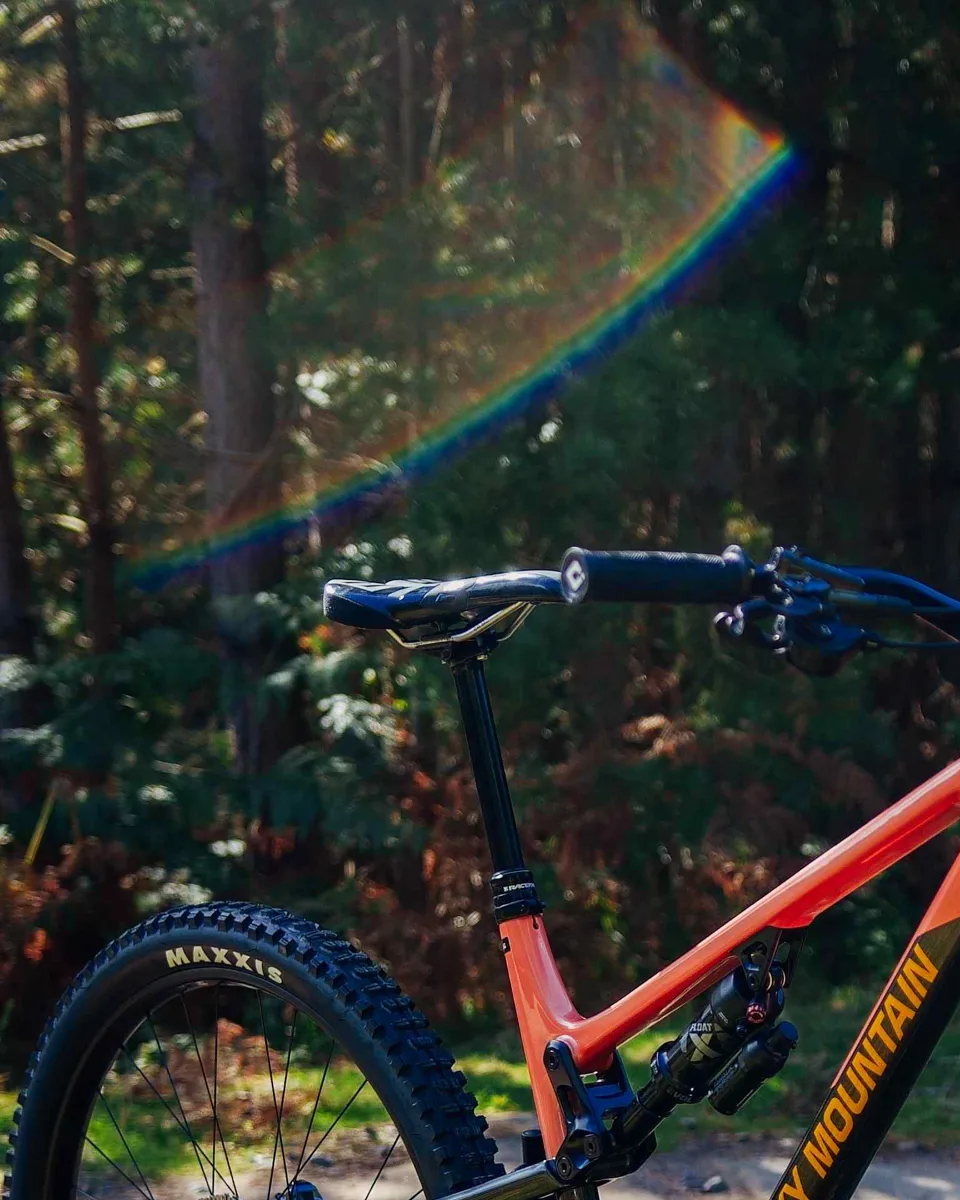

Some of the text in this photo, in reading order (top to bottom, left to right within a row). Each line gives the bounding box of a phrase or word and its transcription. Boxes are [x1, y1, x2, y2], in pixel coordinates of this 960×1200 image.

[165, 945, 283, 984] MAXXIS
[689, 1022, 713, 1032] FLOAT
[803, 943, 939, 1179] MOUNTAIN
